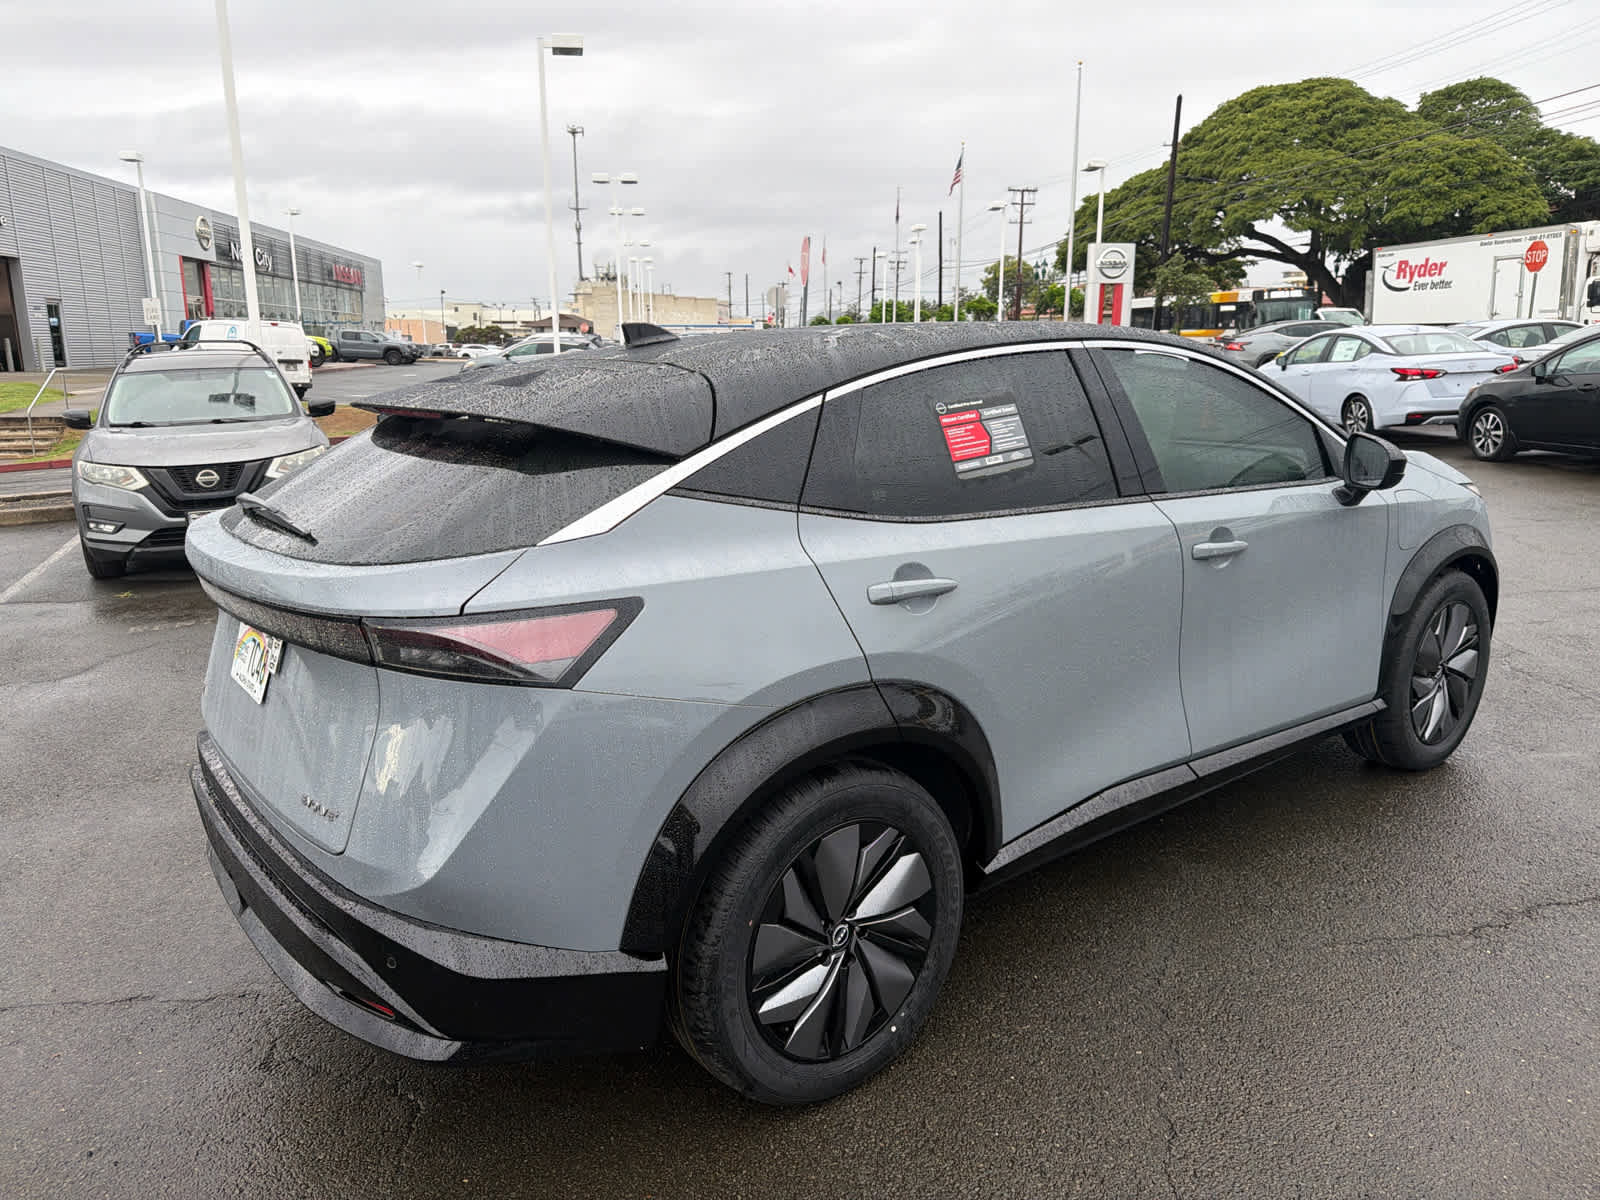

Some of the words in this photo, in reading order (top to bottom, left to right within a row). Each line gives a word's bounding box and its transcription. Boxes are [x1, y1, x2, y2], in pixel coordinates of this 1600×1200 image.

[255, 247, 272, 272] City
[1526, 249, 1547, 264] STOP
[1396, 257, 1448, 284] Ryder
[1413, 280, 1430, 291] Ever
